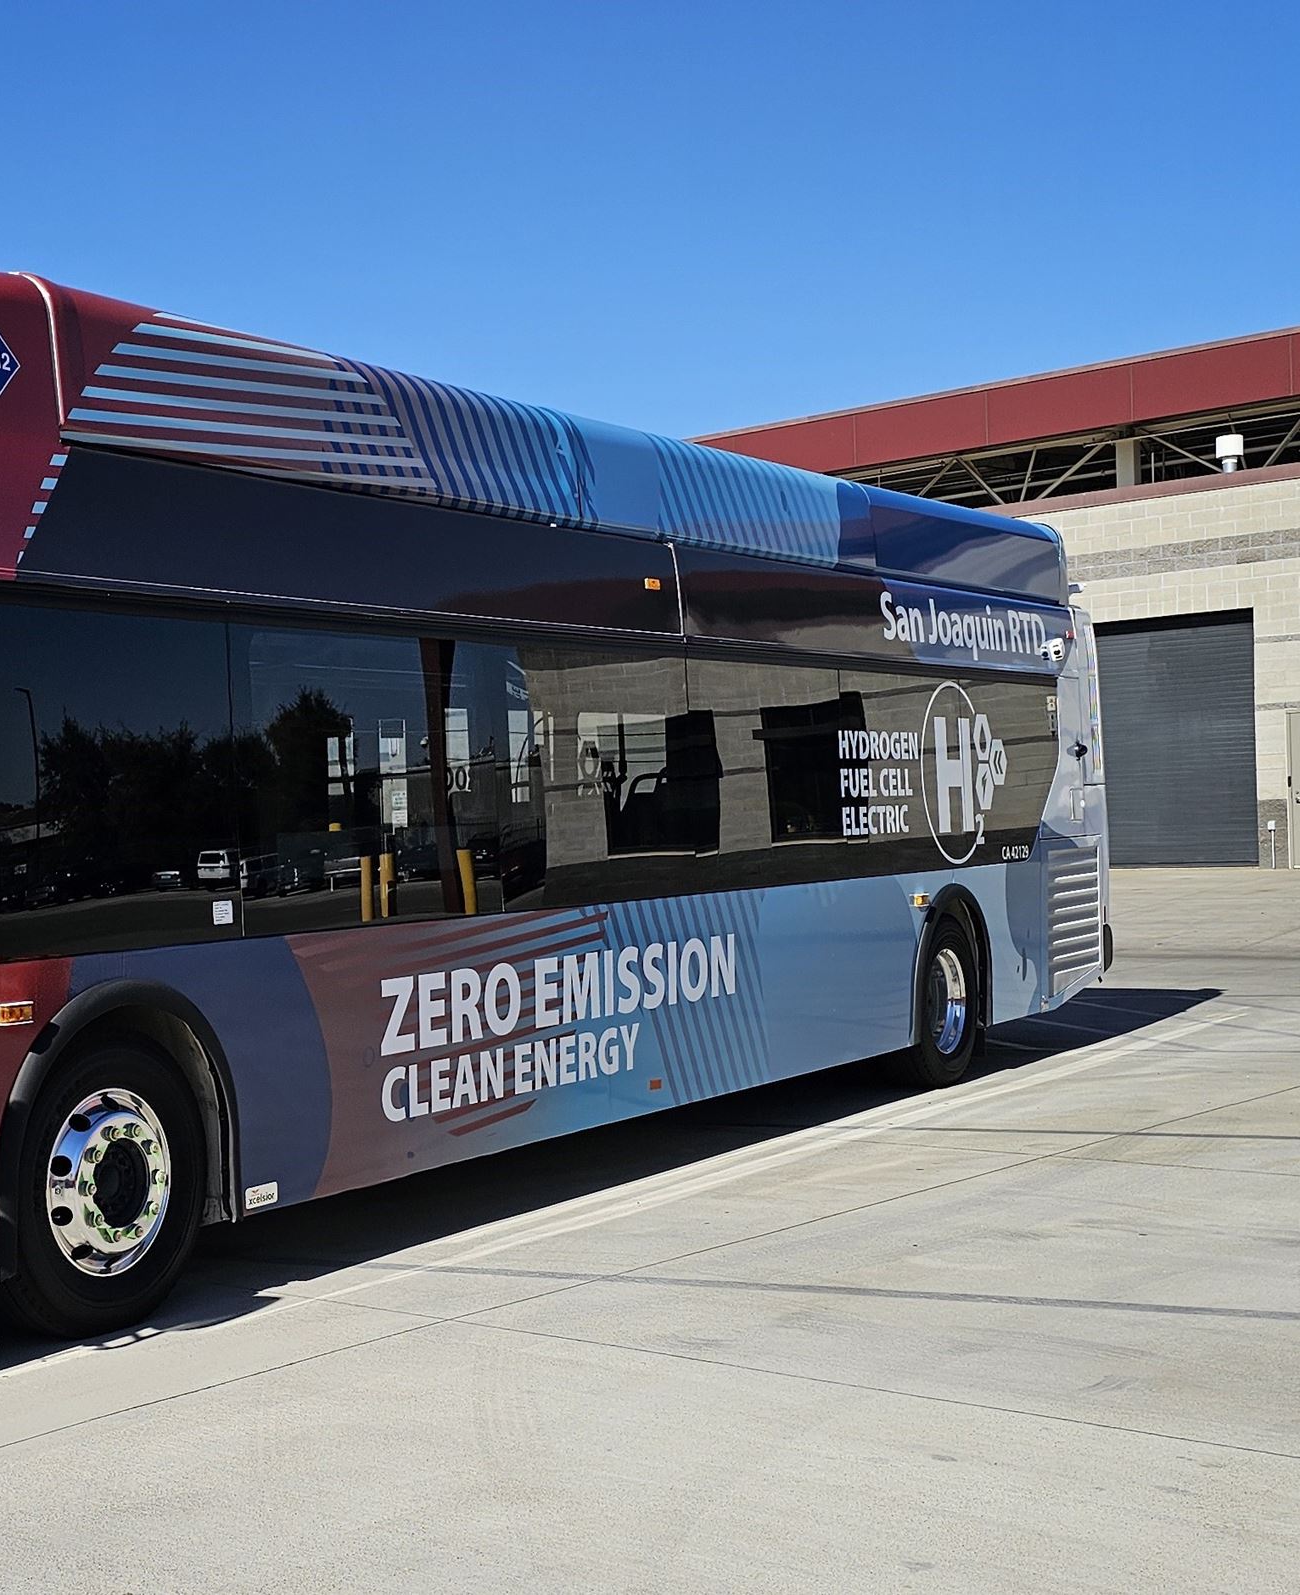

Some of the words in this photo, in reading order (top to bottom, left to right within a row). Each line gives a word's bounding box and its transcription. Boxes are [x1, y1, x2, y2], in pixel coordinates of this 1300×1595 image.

[880, 591, 925, 643] San
[928, 598, 1007, 661] Joaquin
[1007, 609, 1046, 655] RTD
[838, 729, 919, 760] HYDROGEN
[840, 768, 878, 798] FUEL
[879, 767, 913, 797] CELL
[842, 804, 910, 836] ELECTRIC
[380, 962, 522, 1057] ZERO
[534, 933, 736, 1030] EMISSION
[381, 1048, 505, 1123] CLEAN
[514, 1022, 640, 1096] ENERGY
